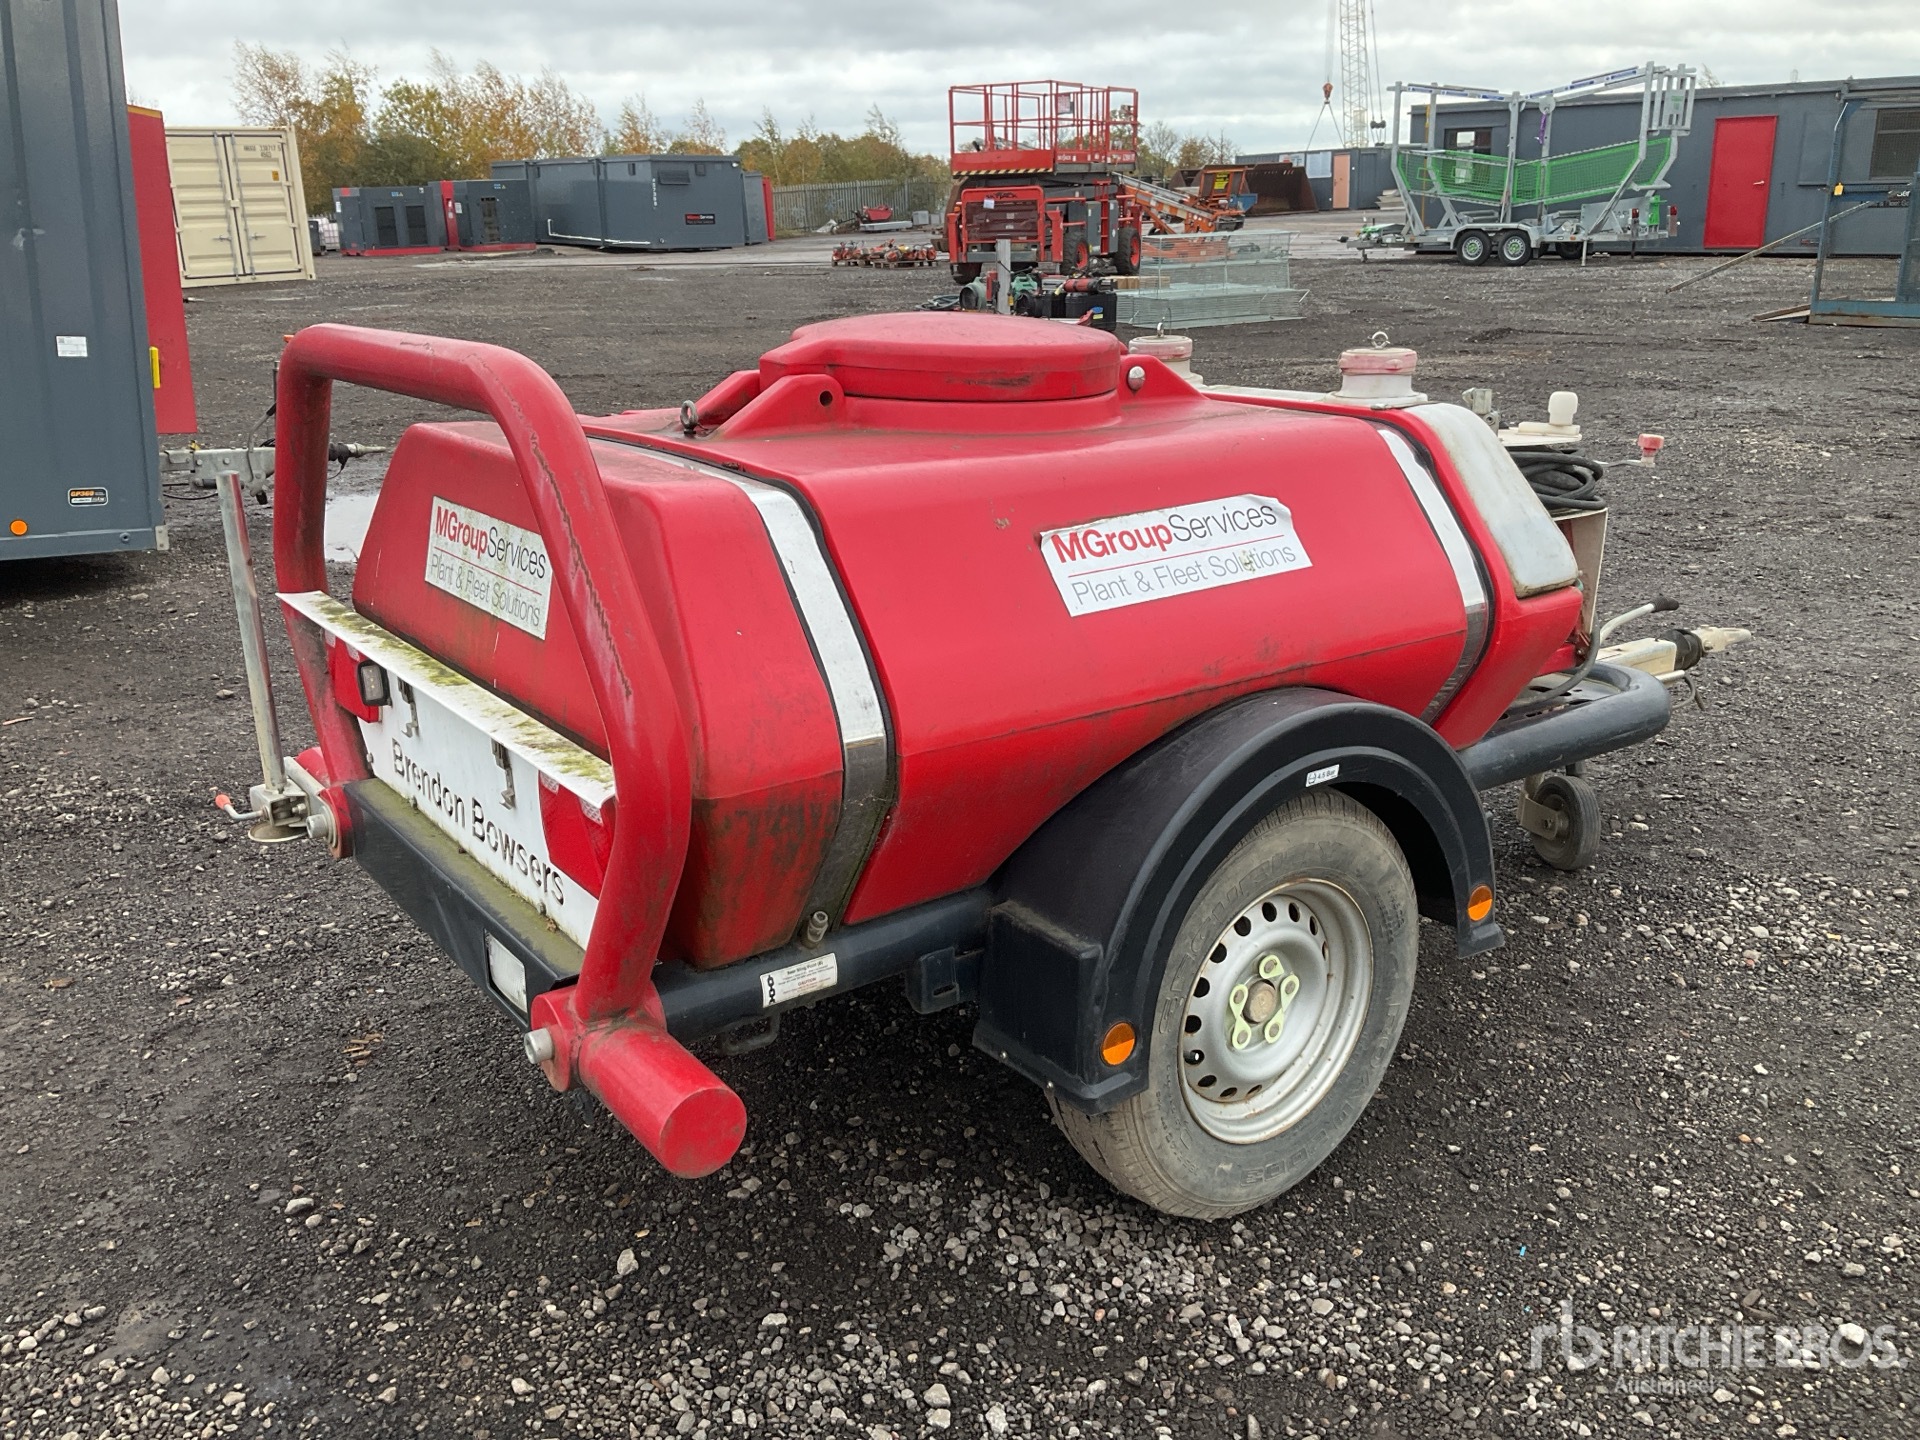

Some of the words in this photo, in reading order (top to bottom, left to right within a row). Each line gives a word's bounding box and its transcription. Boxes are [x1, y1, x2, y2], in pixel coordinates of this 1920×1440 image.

[435, 506, 546, 579] MGroupServices
[1050, 504, 1277, 564] MGroupServices
[431, 553, 454, 586] Plant
[455, 565, 463, 590] &
[466, 567, 490, 603] Fleet
[491, 582, 541, 627] Solutions
[1071, 576, 1132, 605] Plant
[1134, 570, 1154, 593] &
[1153, 560, 1208, 589] Fleet
[1208, 546, 1296, 578] Solutions
[391, 737, 466, 829] Brendon
[472, 797, 565, 906] Bowsers
